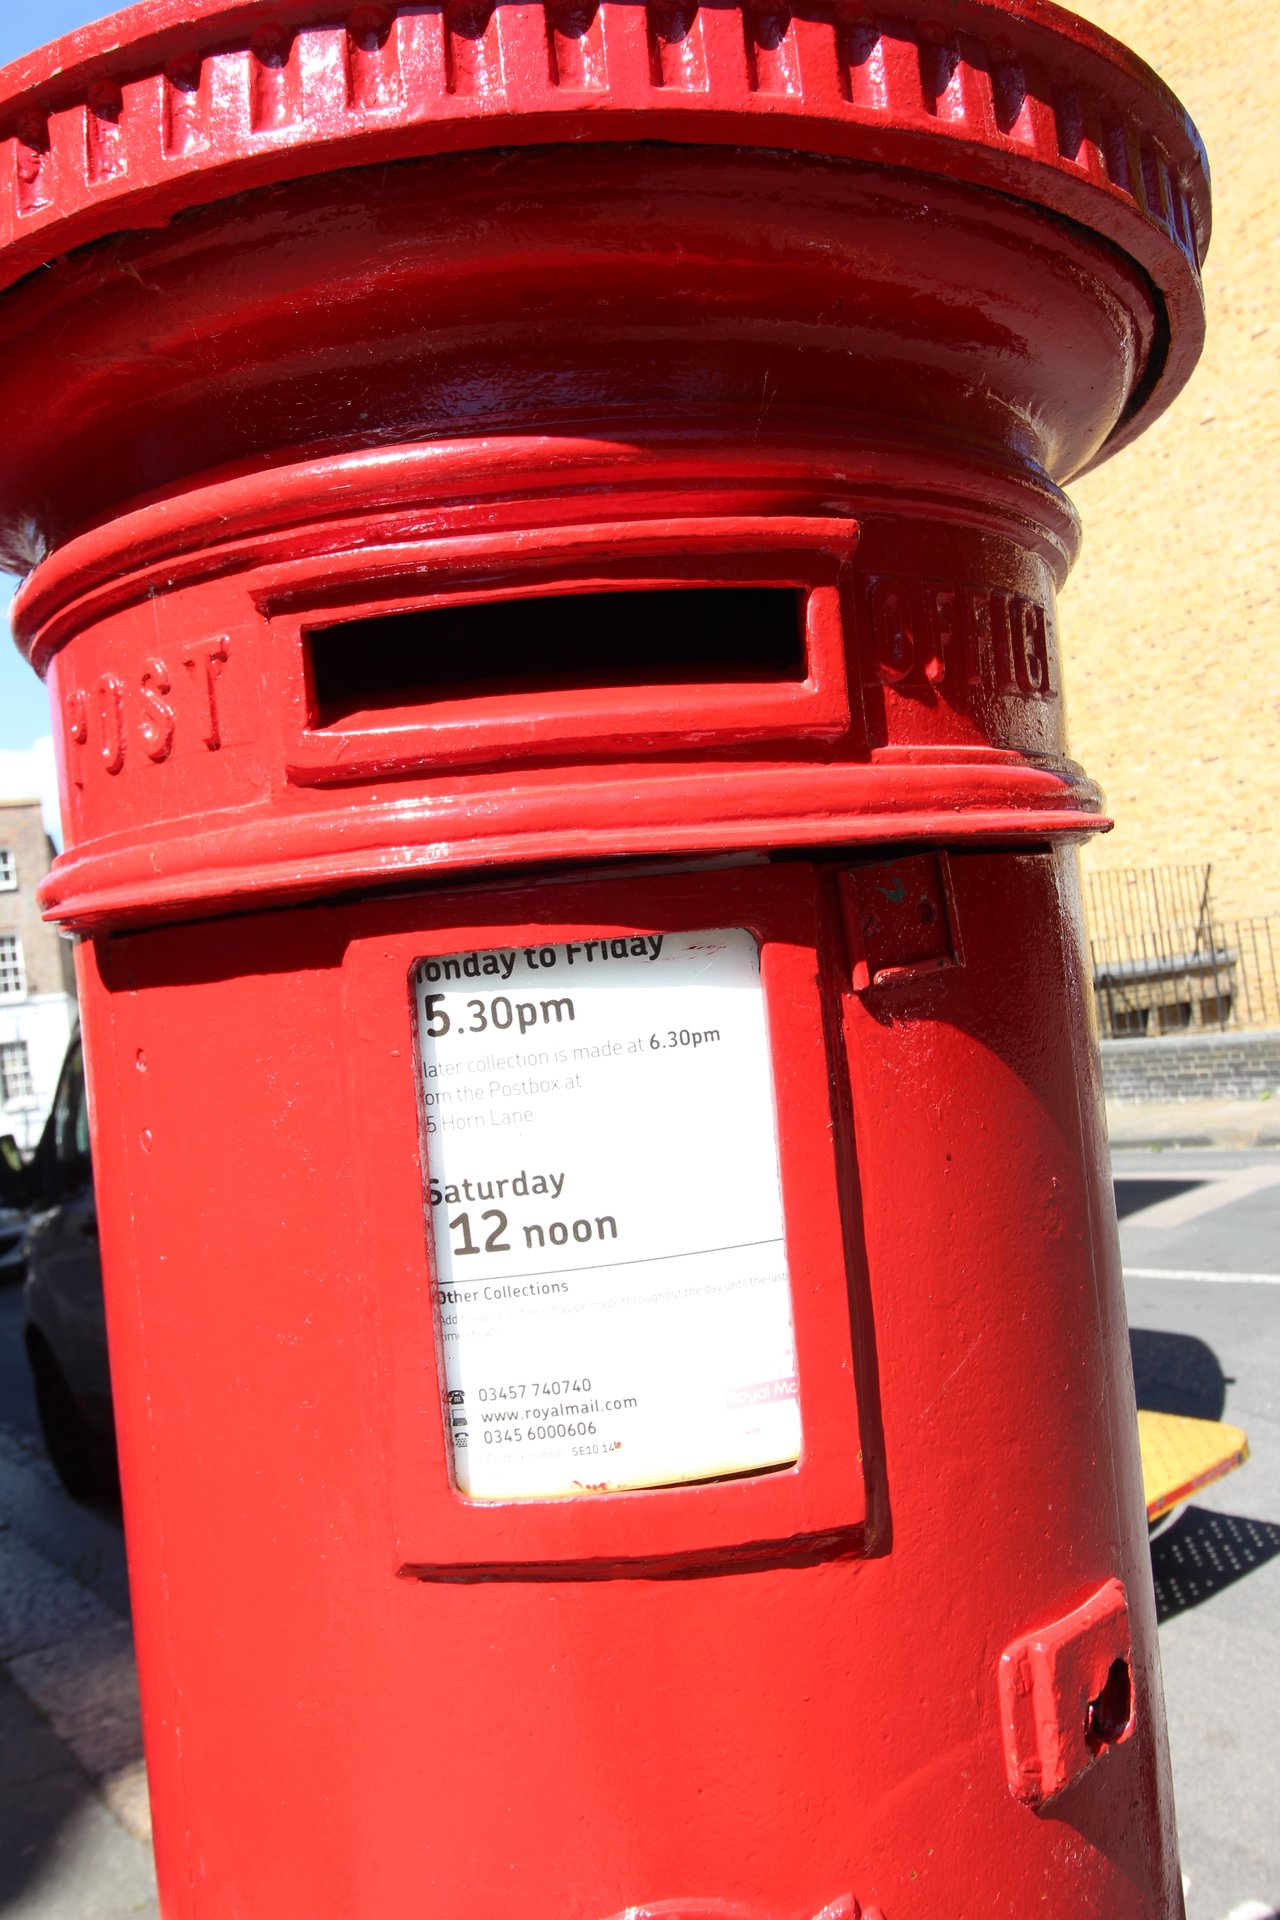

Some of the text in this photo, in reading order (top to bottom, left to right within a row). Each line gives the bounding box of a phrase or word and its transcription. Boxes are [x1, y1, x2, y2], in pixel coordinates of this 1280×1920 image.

[65, 634, 230, 789] POST
[523, 946, 557, 970] to
[566, 935, 664, 965] Friday
[424, 993, 576, 1038] 5.30pm
[468, 1047, 550, 1073] collection
[554, 1045, 568, 1063] is
[573, 1037, 622, 1060] made
[627, 1036, 645, 1054] at
[650, 1027, 720, 1051] 6.30pm
[425, 1072, 582, 1106] om the Postbox at
[441, 1112, 485, 1132] Horn
[490, 1107, 534, 1127] Lane
[430, 1170, 565, 1206] Saturday
[449, 1208, 618, 1256] 12 noon
[484, 1281, 569, 1301] Collections
[622, 1289, 683, 1306] throughout
[685, 1285, 702, 1297] the
[704, 1282, 722, 1296] day
[725, 1278, 747, 1292] until
[749, 1275, 766, 1287] the
[768, 1272, 788, 1284] last
[478, 1378, 592, 1403] 03457 740740
[727, 1383, 770, 1404] Royal
[481, 1396, 638, 1424] www.royalmail.com
[484, 1421, 597, 1445] 0345 6000606
[571, 1444, 599, 1457] SE10
